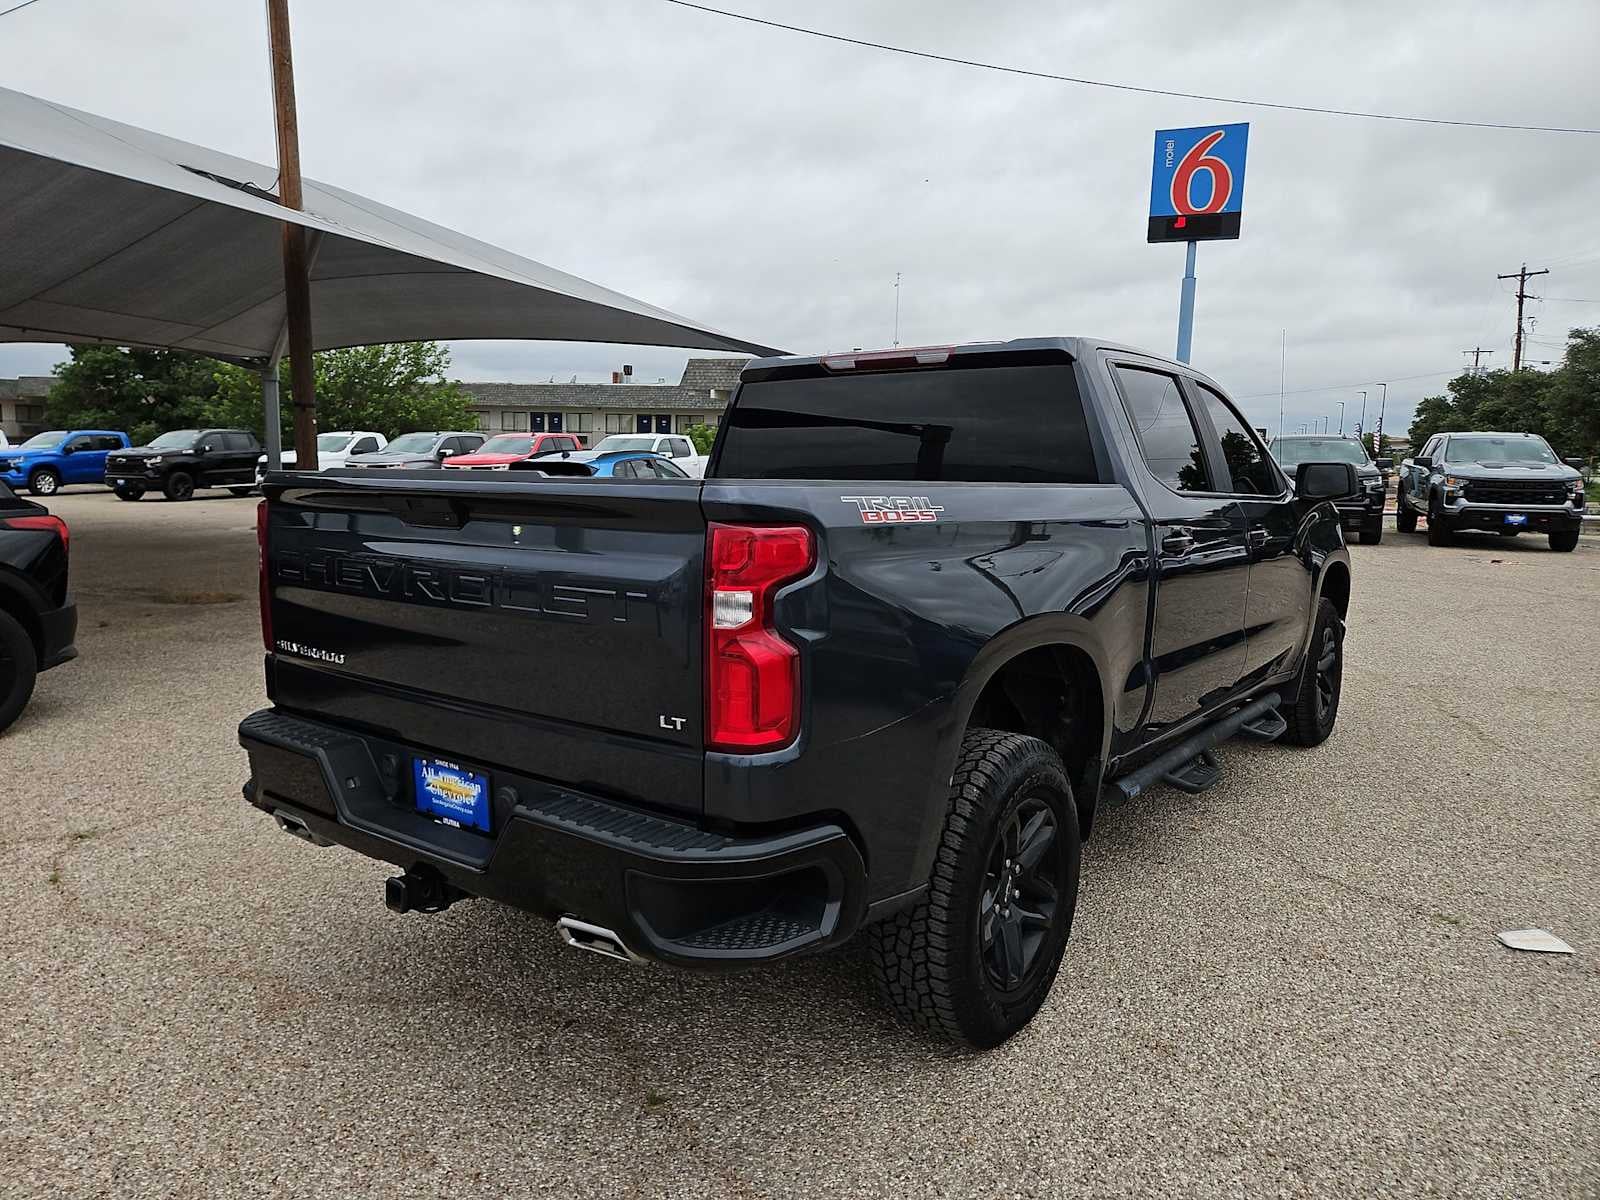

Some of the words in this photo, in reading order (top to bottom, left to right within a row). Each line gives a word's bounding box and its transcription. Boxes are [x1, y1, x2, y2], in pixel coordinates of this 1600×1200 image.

[1165, 140, 1176, 168] motel
[1170, 129, 1233, 216] 6
[840, 496, 945, 512] TRAIL
[861, 511, 937, 523] BOSS
[276, 550, 648, 623] CHEVROLET
[660, 715, 687, 730] LT
[429, 783, 478, 806] Chevrolet
